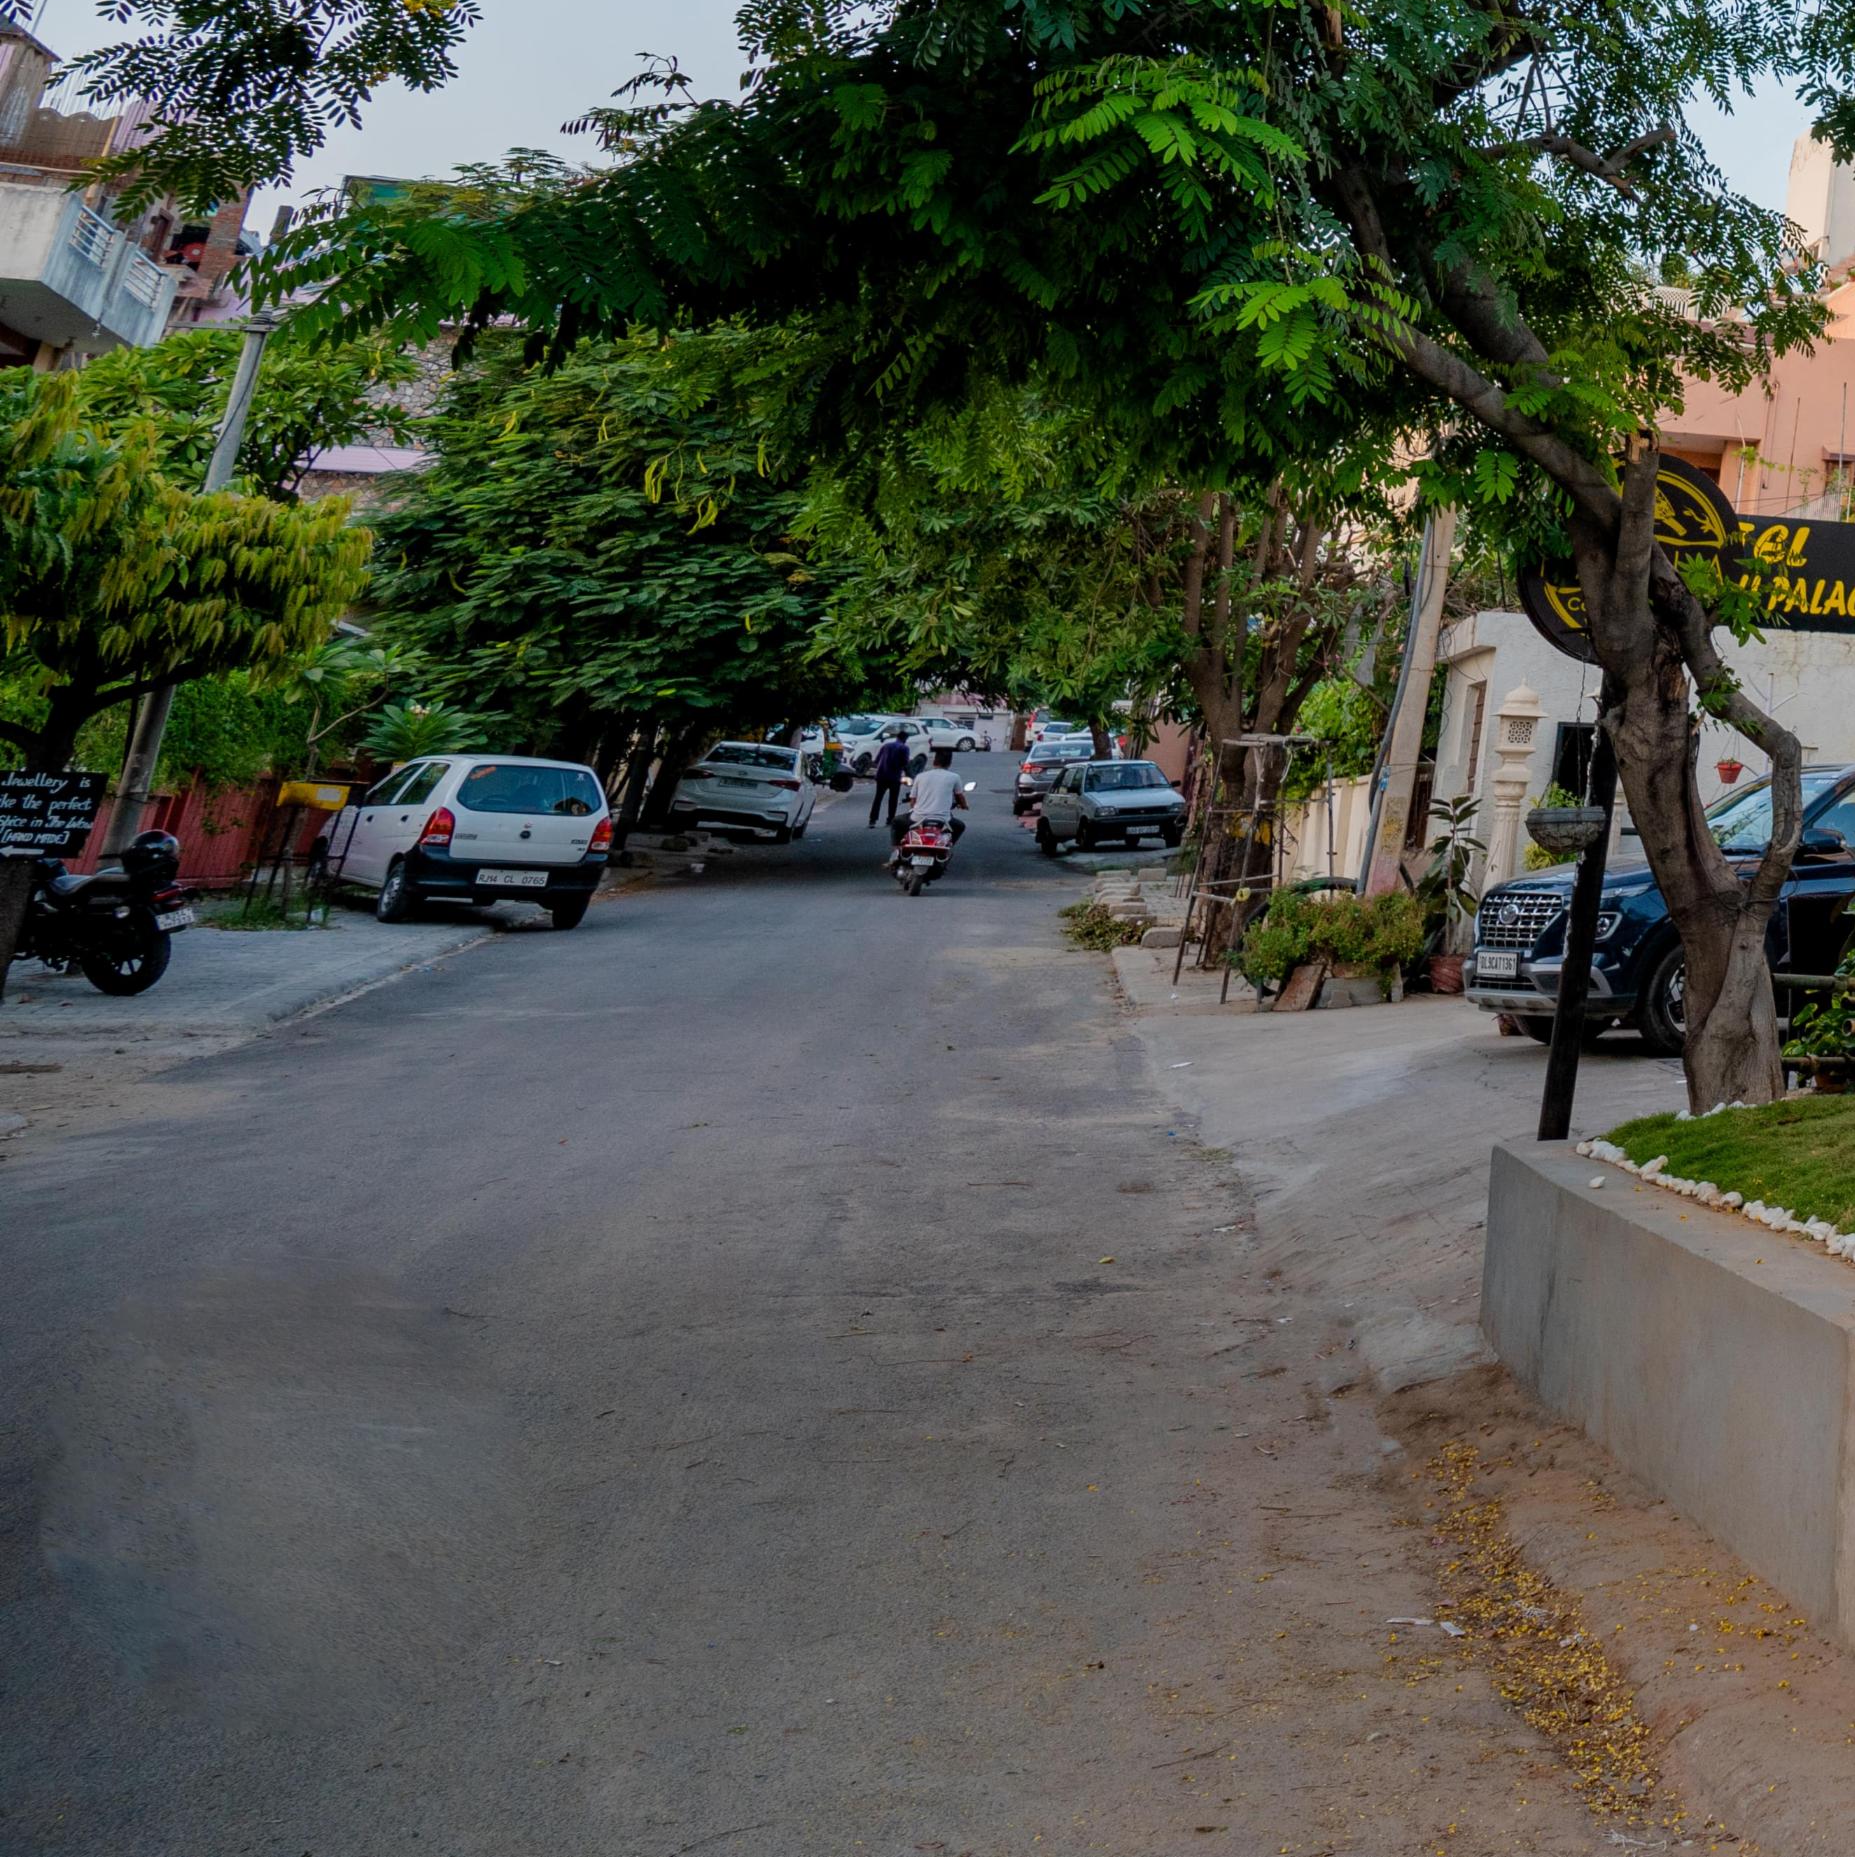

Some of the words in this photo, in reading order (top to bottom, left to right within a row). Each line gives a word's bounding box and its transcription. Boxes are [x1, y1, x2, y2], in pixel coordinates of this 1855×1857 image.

[2, 772, 68, 794] Jewellery
[79, 777, 91, 787] is
[22, 794, 43, 809] the
[47, 796, 92, 815] perfect
[30, 816, 43, 827] in
[521, 876, 546, 886] 0765
